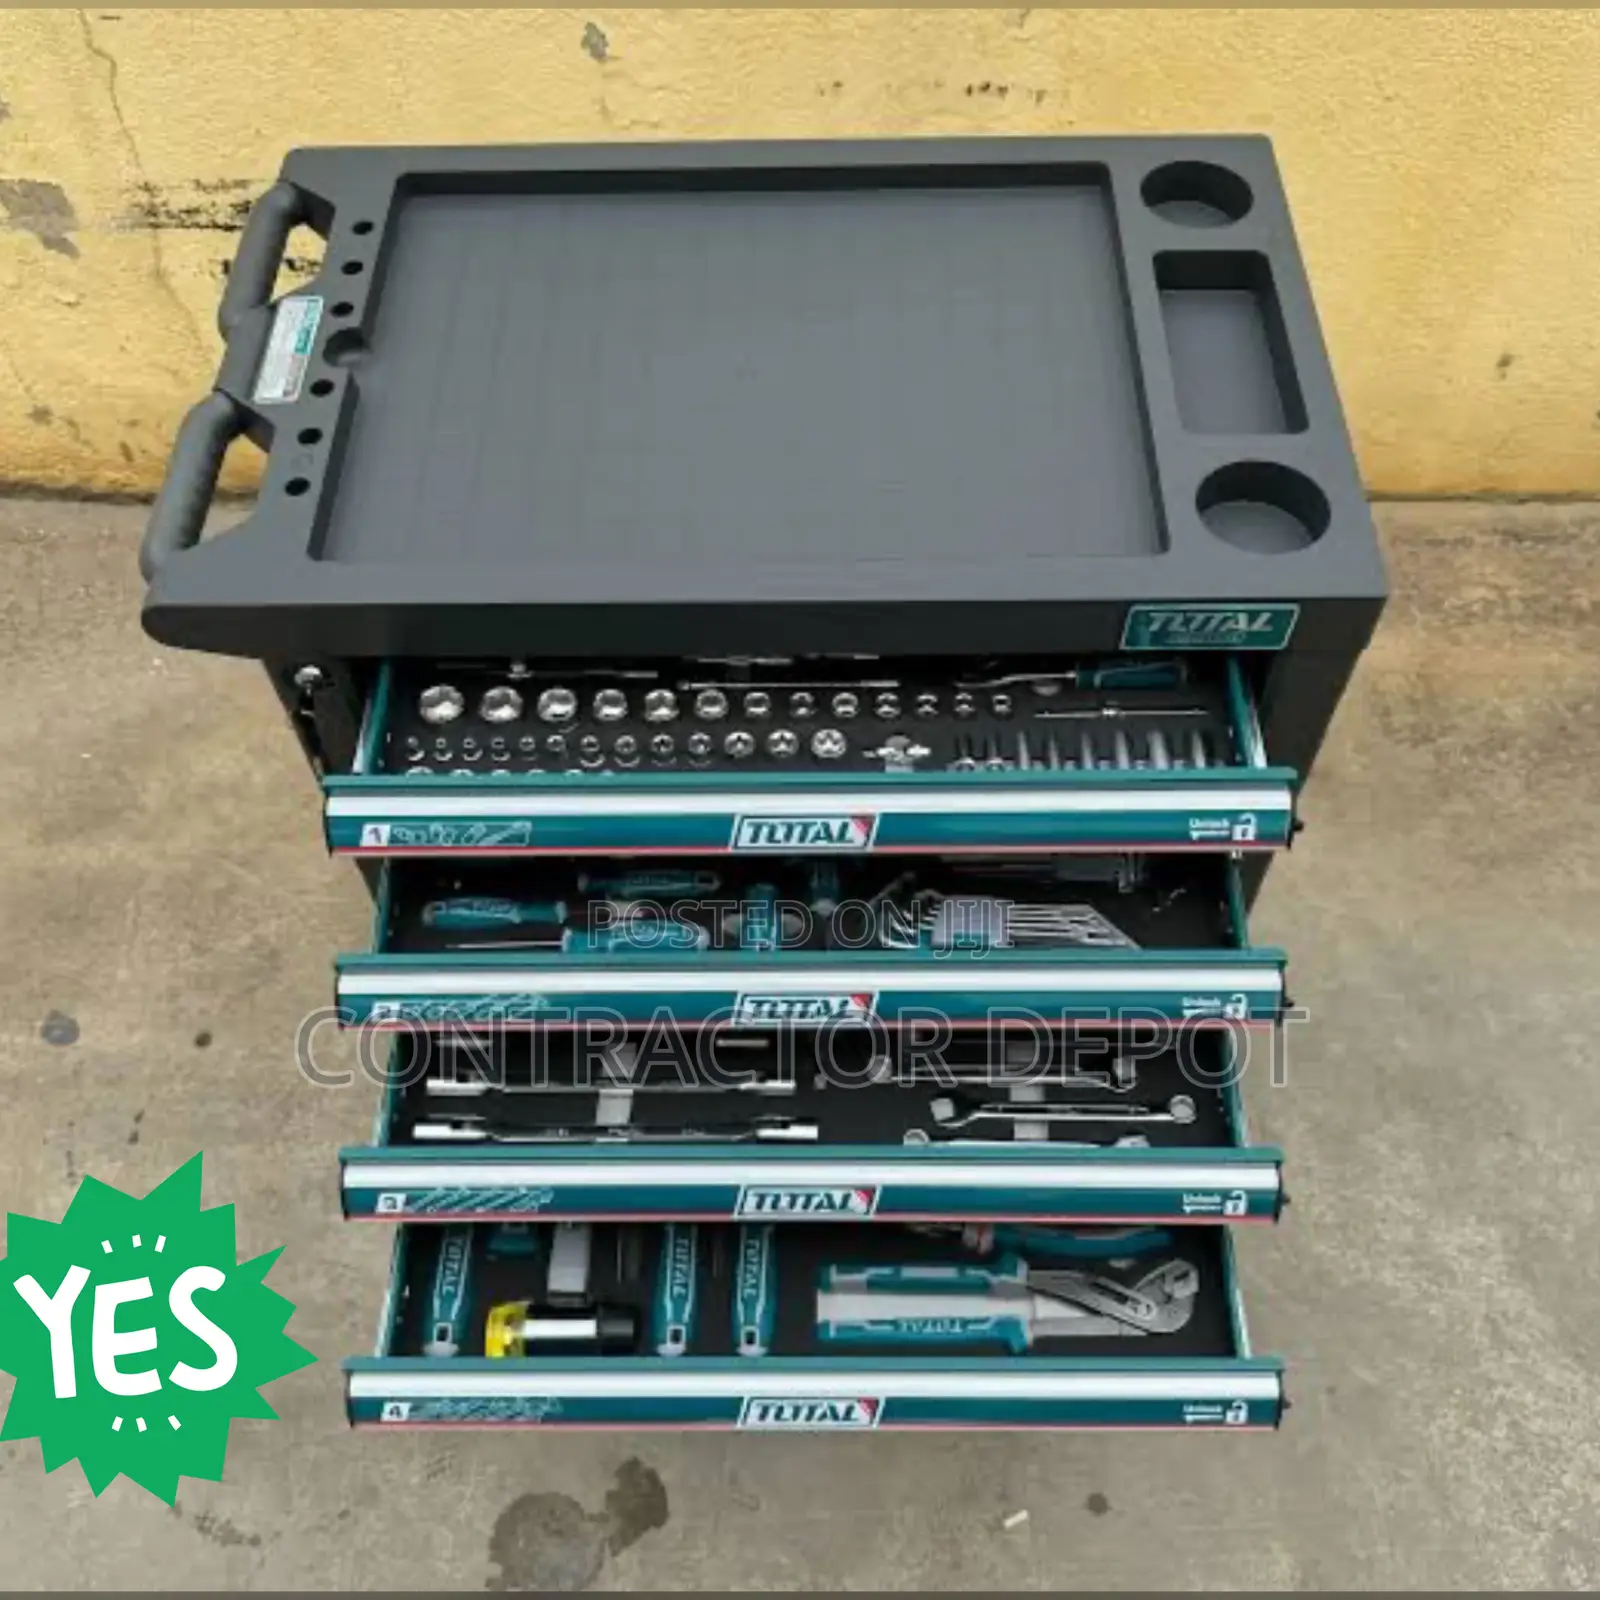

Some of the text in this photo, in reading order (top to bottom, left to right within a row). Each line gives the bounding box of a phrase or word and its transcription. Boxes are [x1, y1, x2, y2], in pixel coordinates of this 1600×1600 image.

[1148, 611, 1274, 632] TOTAL
[746, 820, 854, 844] TOTAL
[752, 1192, 856, 1213] TOTAL
[756, 1401, 859, 1422] TOTAL
